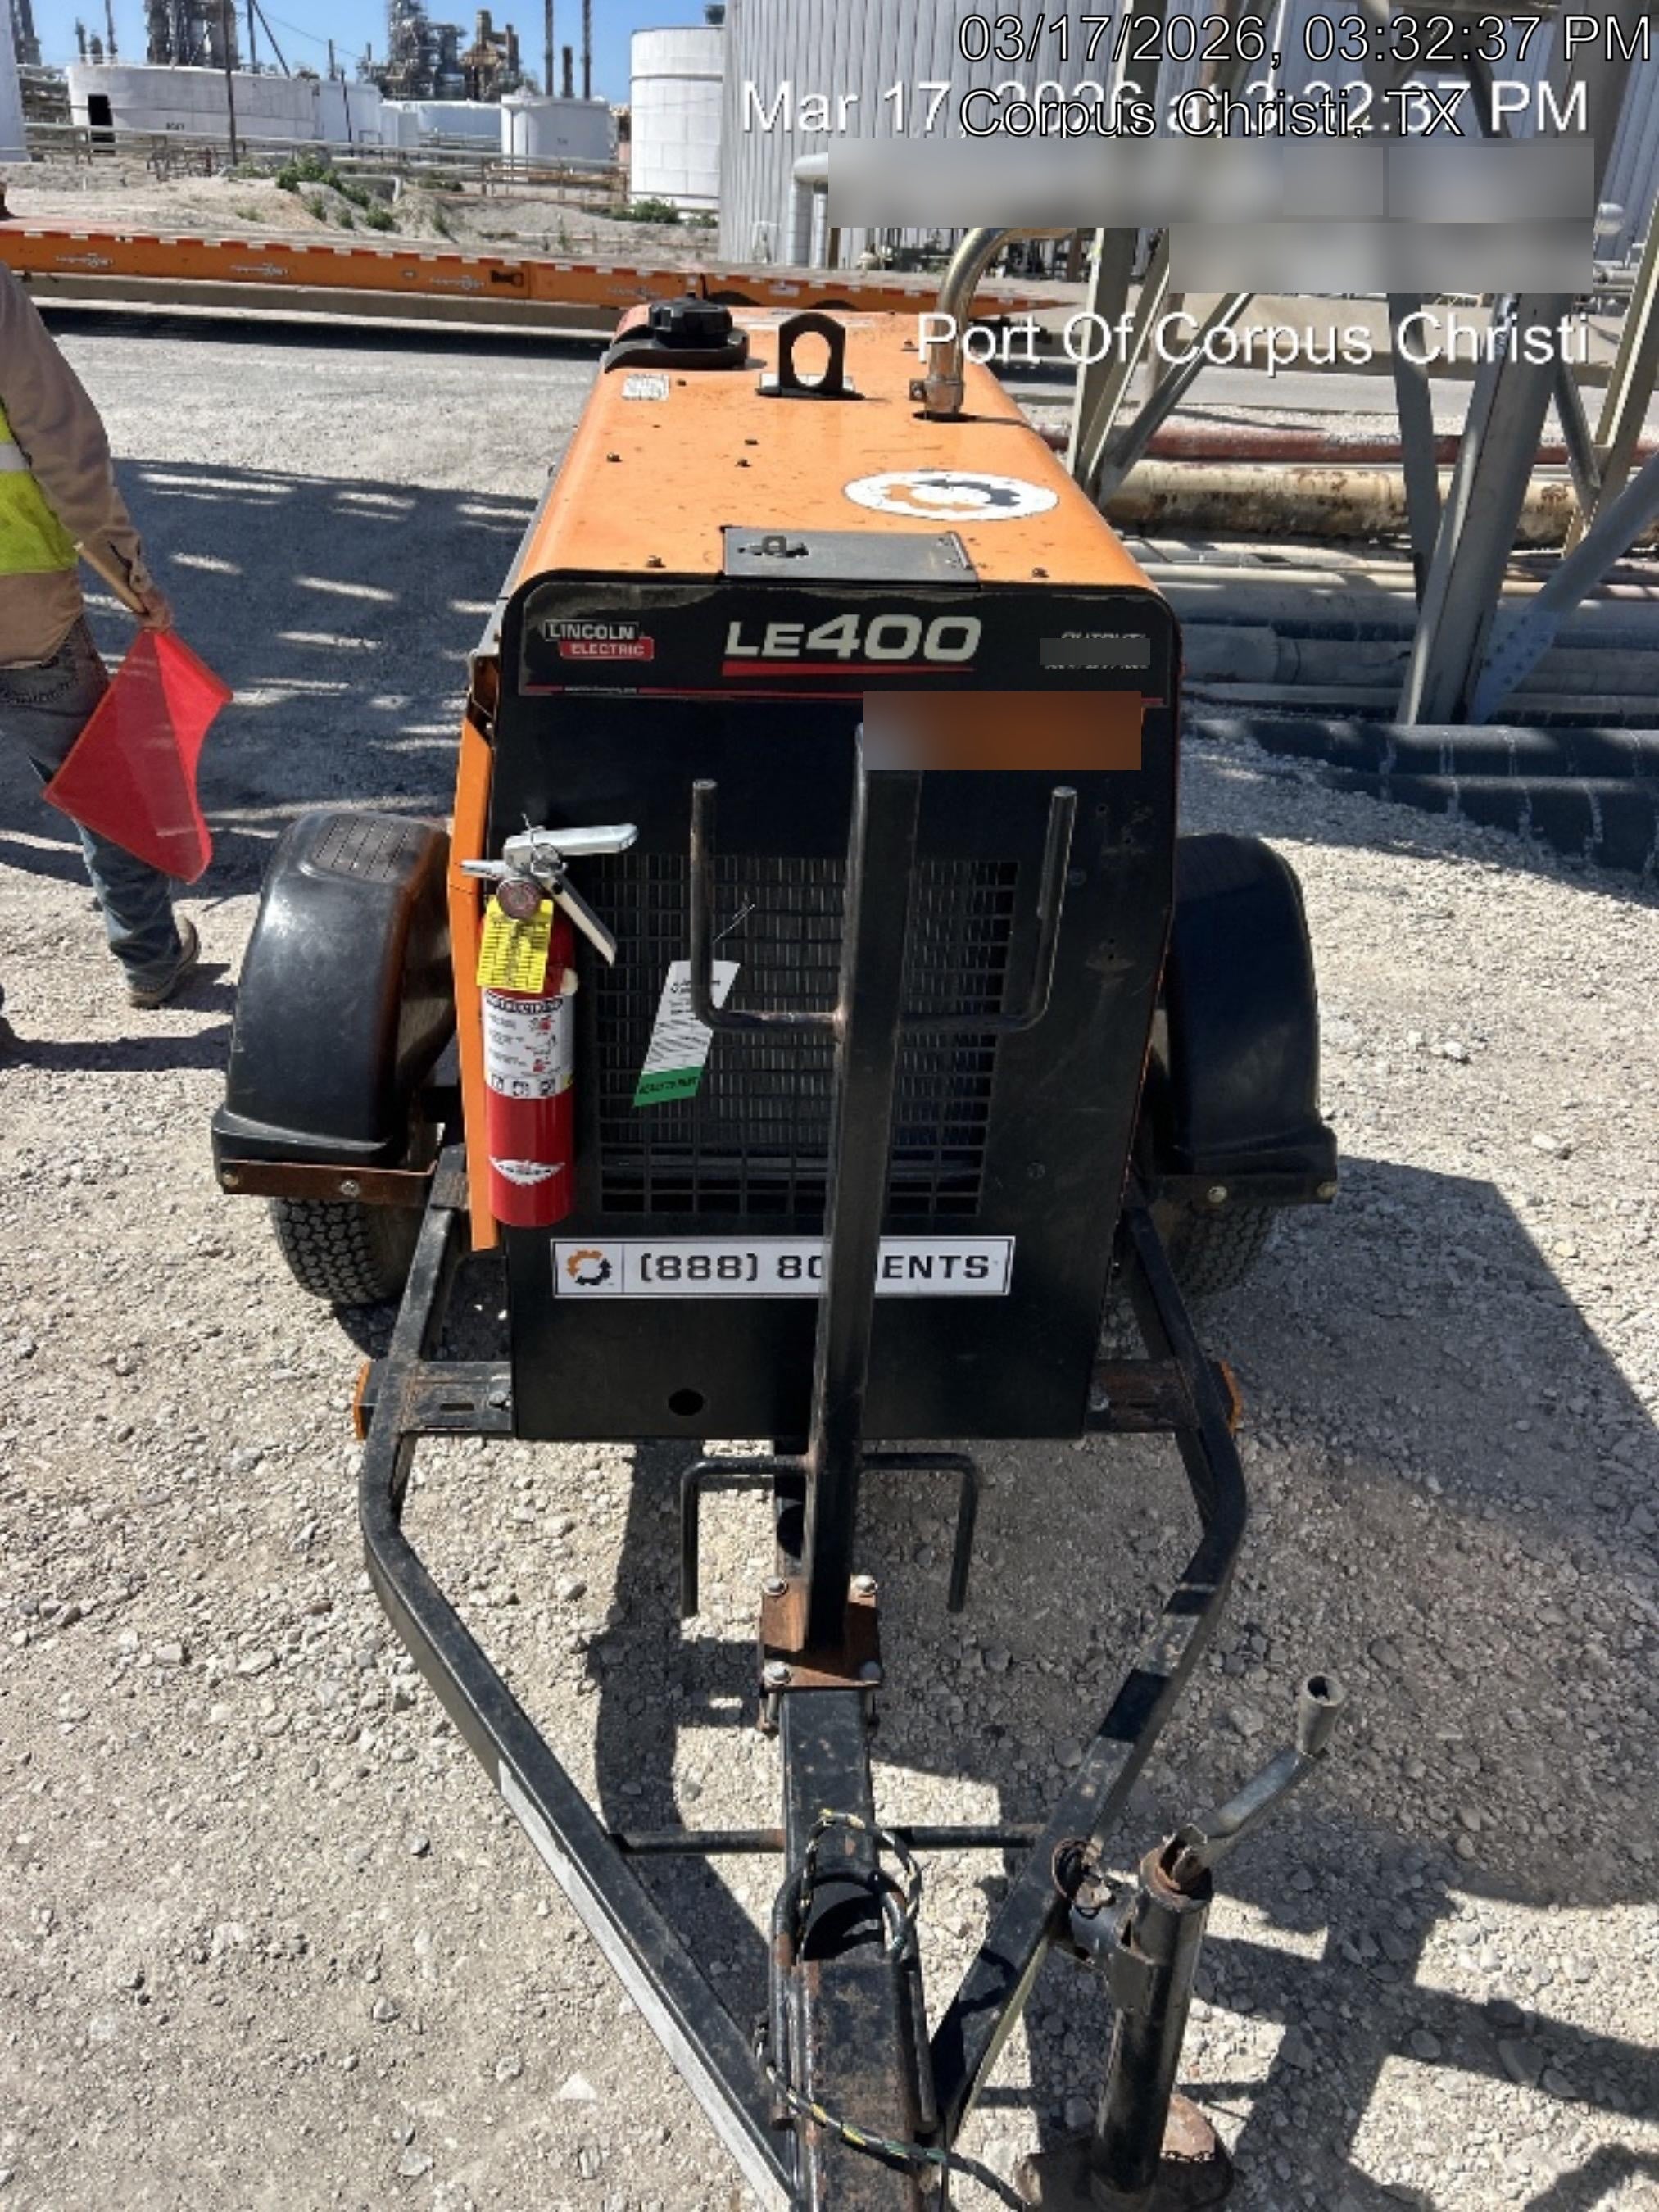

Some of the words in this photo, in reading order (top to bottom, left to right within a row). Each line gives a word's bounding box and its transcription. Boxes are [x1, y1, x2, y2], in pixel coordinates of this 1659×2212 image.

[549, 623, 636, 641] LINCOLN
[724, 614, 982, 662] LE400
[570, 642, 646, 655] ELECTRIC
[640, 1253, 759, 1282] (888)
